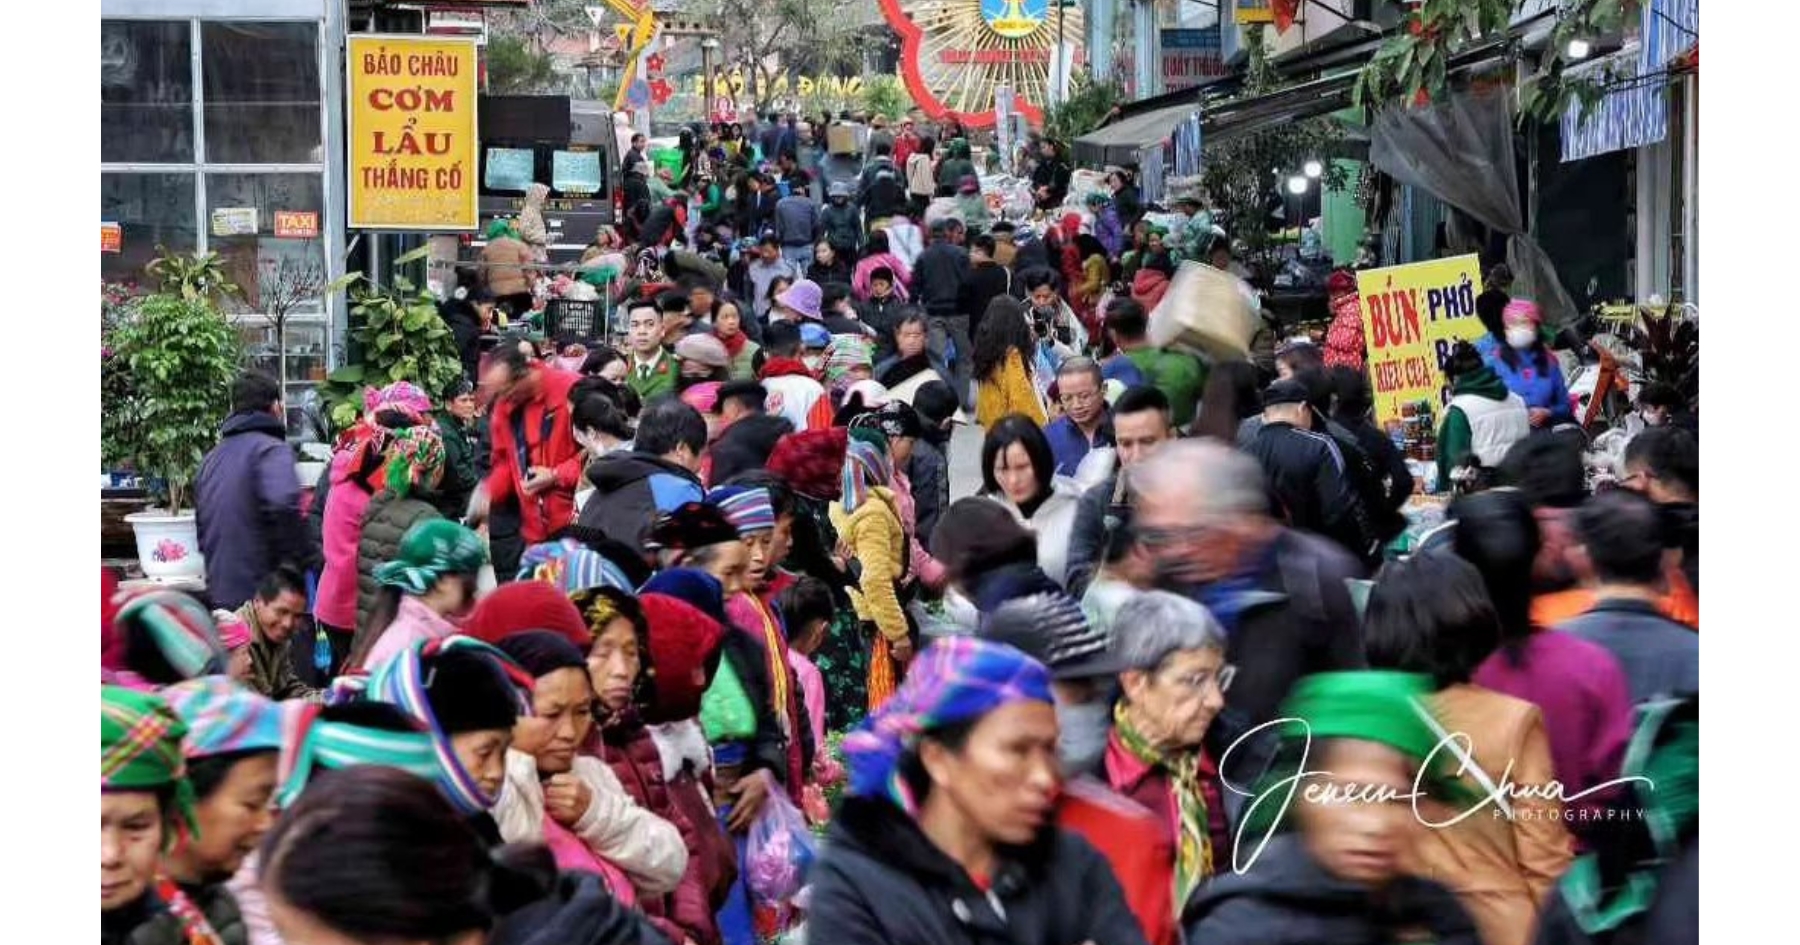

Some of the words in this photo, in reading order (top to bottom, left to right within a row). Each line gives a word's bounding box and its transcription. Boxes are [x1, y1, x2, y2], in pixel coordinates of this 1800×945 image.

[363, 46, 402, 76] BẢO
[408, 51, 459, 78] CHÂU
[368, 85, 455, 113] CƠM
[372, 117, 452, 155] LẨU
[362, 159, 429, 190] THẮNG
[435, 160, 463, 190] CỐ
[279, 214, 315, 229] TAXI
[1367, 275, 1421, 348] BÚN
[1427, 272, 1475, 321] PHỞ
